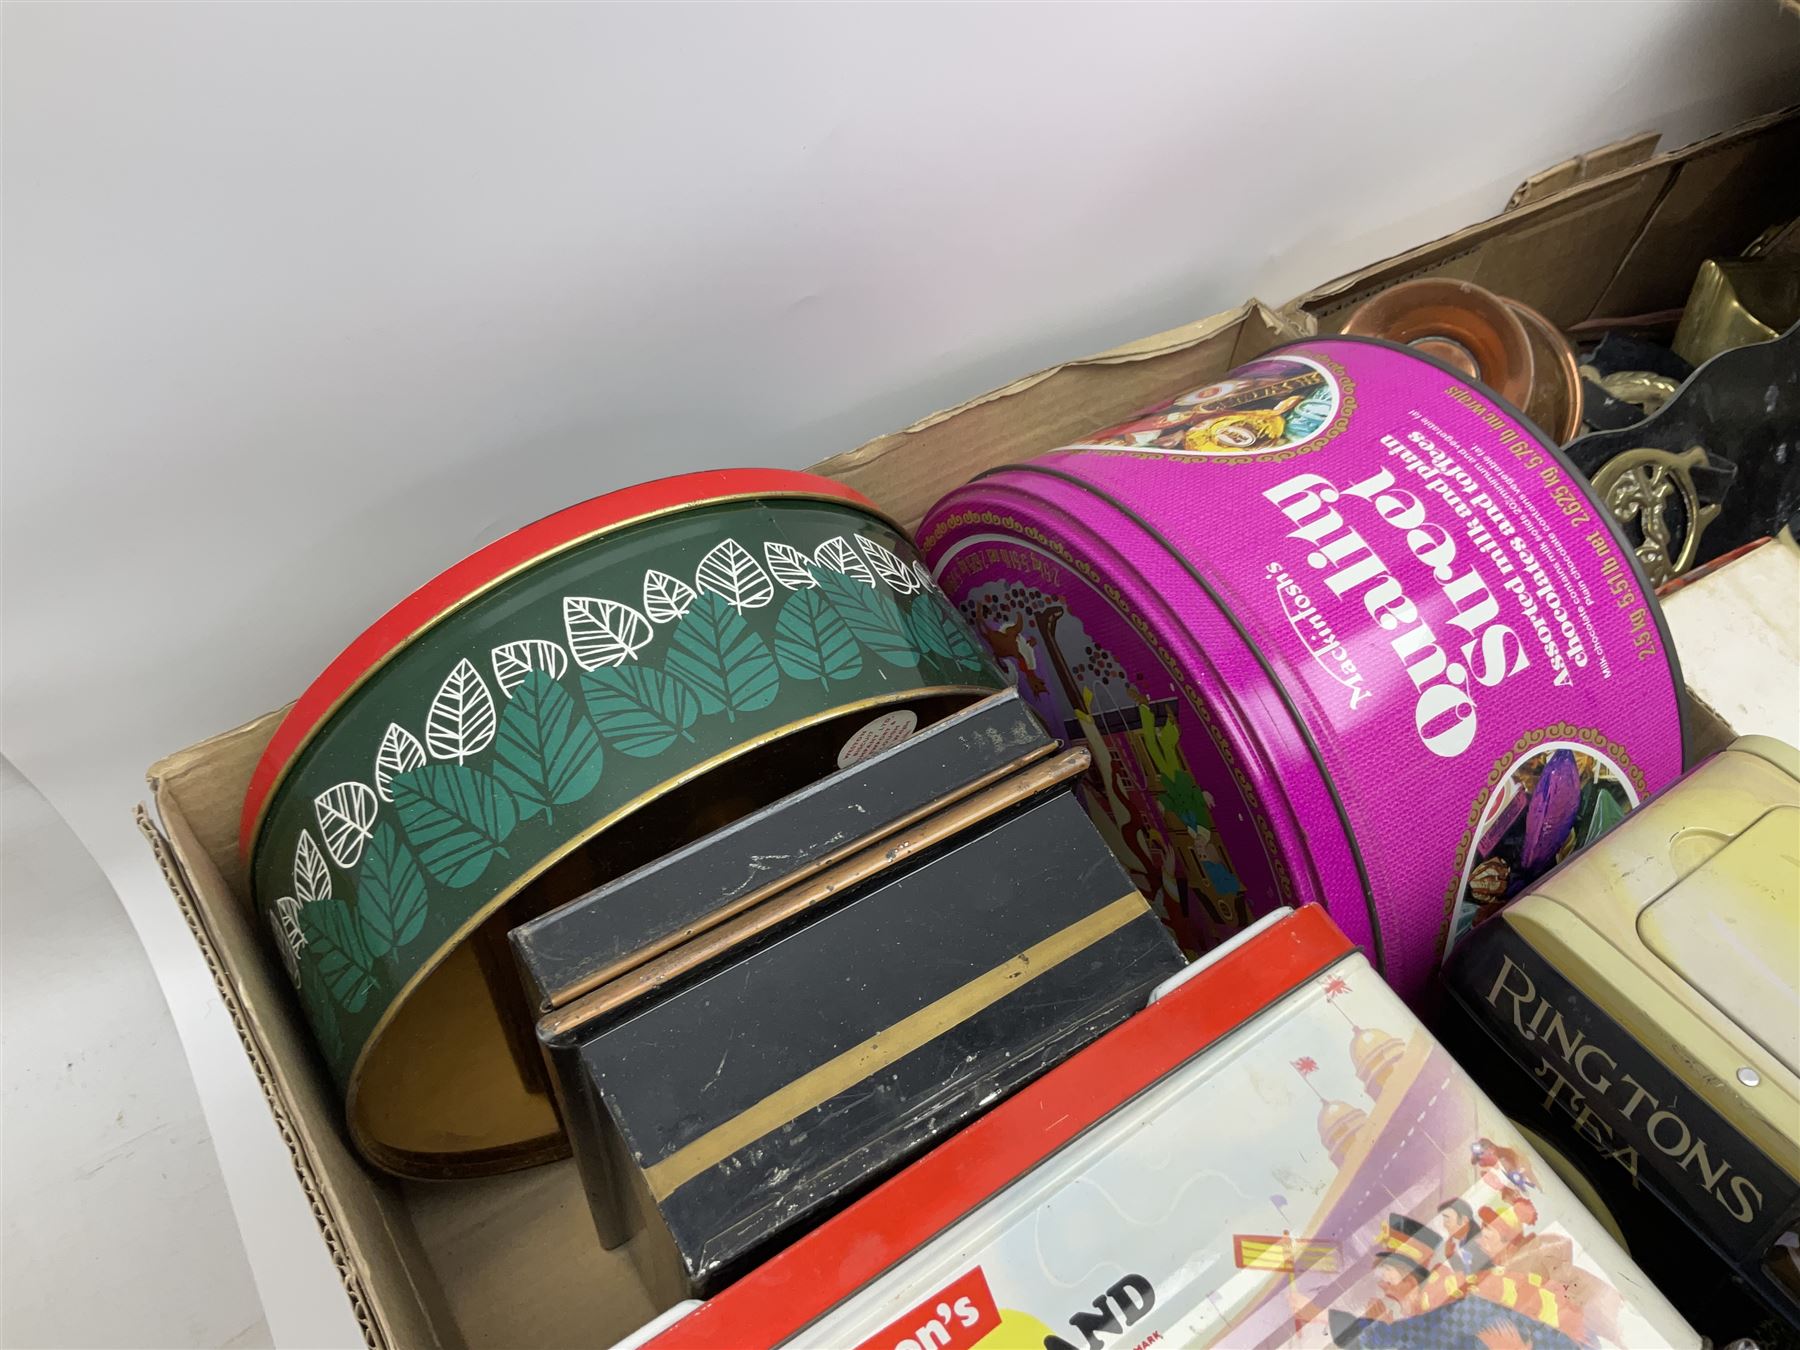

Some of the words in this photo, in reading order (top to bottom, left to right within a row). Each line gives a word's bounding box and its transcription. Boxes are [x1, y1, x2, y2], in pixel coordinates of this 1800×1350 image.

[1408, 409, 1423, 420] fat
[1445, 386, 1485, 415] wraps
[1420, 417, 1461, 450] vegetable
[1482, 413, 1505, 430] inc
[1500, 429, 1518, 444] lb
[1381, 435, 1441, 479] plain
[1408, 432, 1478, 494] toffees
[1457, 448, 1477, 464] and
[1509, 441, 1543, 469] 5.79
[1482, 455, 1521, 495] vegetable
[1540, 467, 1560, 488] kg
[1425, 478, 1472, 518] and
[1470, 493, 1515, 535] and
[1518, 493, 1551, 532] contains
[1550, 486, 1590, 527] 2.625
[1467, 517, 1514, 575] milk
[1519, 514, 1543, 542] solids
[1586, 531, 1610, 556] net
[1539, 541, 1557, 563] milk
[1547, 532, 1581, 580] chocolate
[1601, 557, 1619, 575] lb
[1337, 467, 1530, 686] Street
[1552, 561, 1581, 605] contains
[1578, 580, 1595, 606] Plain
[1607, 573, 1634, 608] 5.51
[1262, 474, 1477, 757] Quality
[1510, 537, 1587, 667] chocolates
[1630, 608, 1645, 633] kg
[1266, 562, 1375, 712] Mackintosh's
[1504, 576, 1573, 686] Assorted
[1577, 605, 1604, 656] chocolate
[1633, 631, 1655, 660] 2.5
[1599, 655, 1613, 679] Milk
[1485, 954, 1763, 1223] RINGTONS
[1534, 1059, 1642, 1191] TEA
